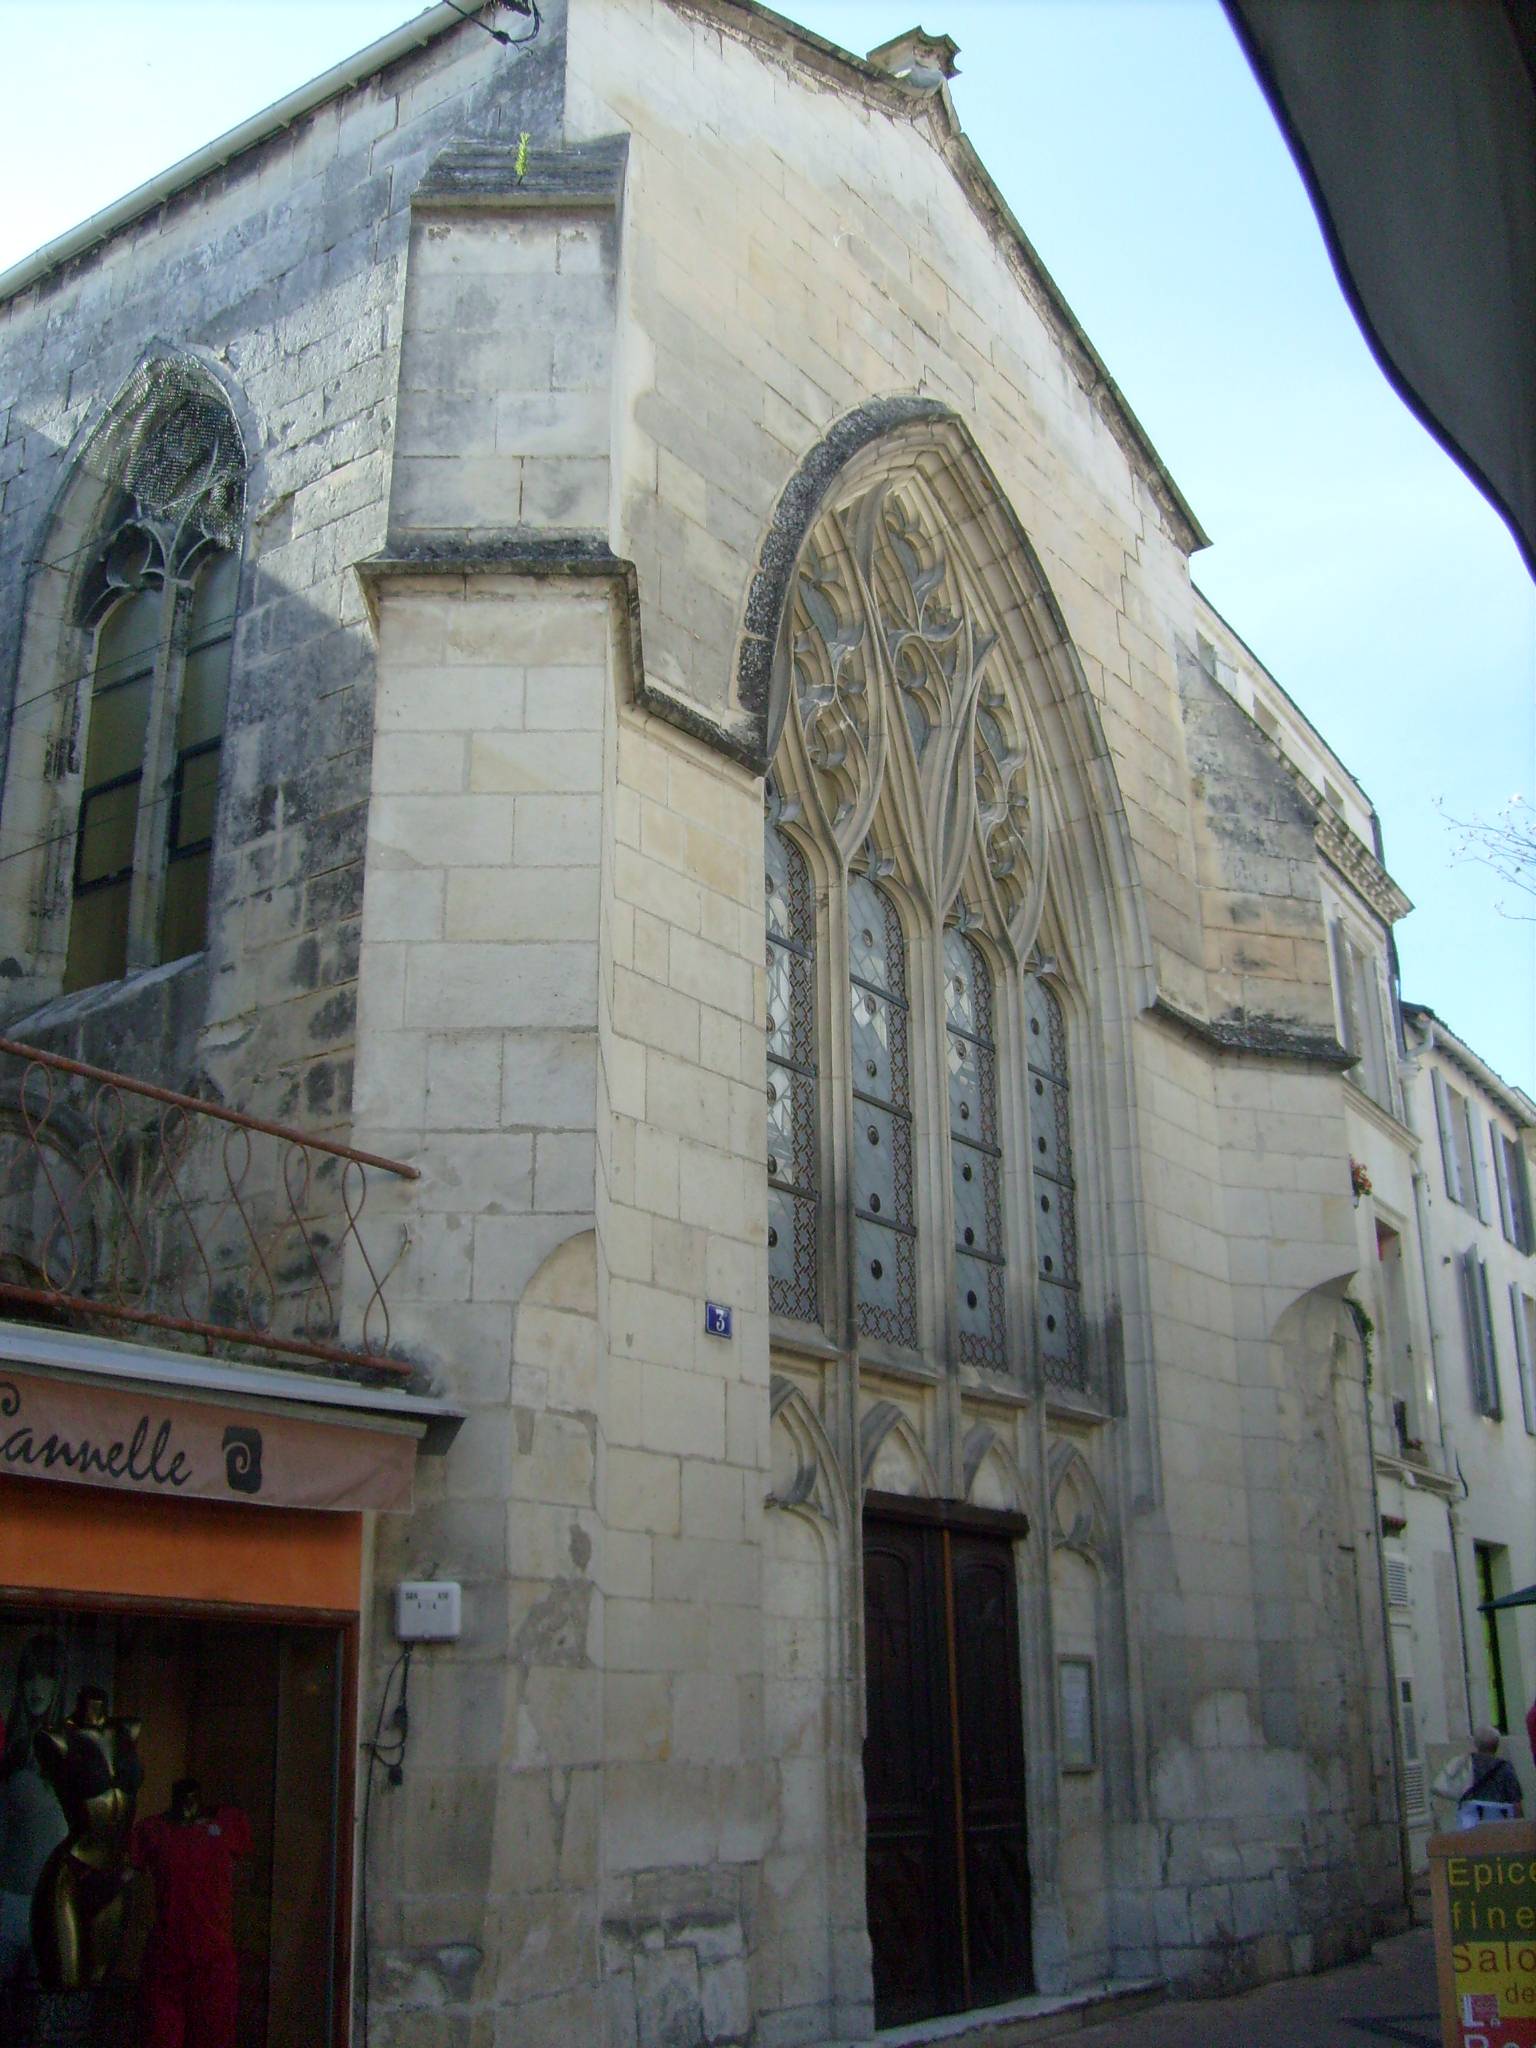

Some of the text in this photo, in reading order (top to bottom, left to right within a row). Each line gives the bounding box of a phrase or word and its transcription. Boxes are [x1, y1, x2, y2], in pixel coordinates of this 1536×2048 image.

[715, 1308, 725, 1331] 3
[1452, 1900, 1536, 1931] fine
[1505, 1982, 1535, 2004] de
